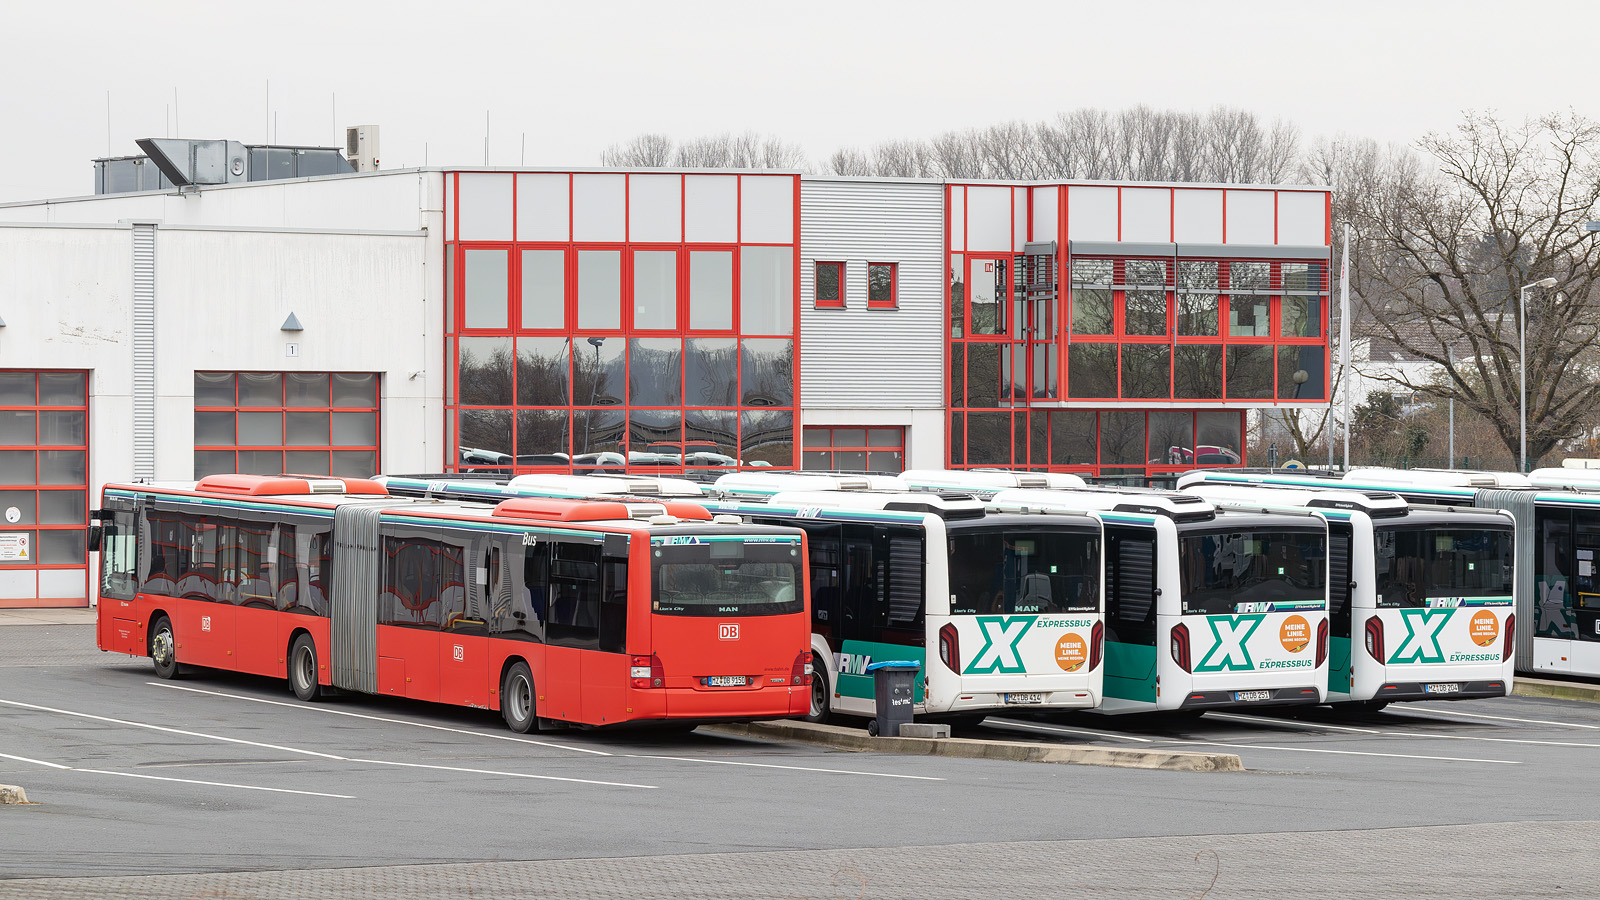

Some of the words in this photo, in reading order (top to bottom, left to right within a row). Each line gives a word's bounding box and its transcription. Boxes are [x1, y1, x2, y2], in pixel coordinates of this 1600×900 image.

[522, 532, 537, 546] Bus
[671, 536, 693, 545] RMV
[1244, 601, 1272, 613] RMV
[1436, 597, 1464, 608] RMV
[1036, 619, 1092, 628] EXPRESSBUS
[1284, 623, 1305, 631] MEINE
[720, 625, 739, 639] DB
[1386, 608, 1458, 665] X
[962, 615, 1040, 675] X
[1192, 614, 1268, 673] X
[454, 646, 463, 660] DB
[1449, 653, 1500, 662] EXPRESSBUS
[838, 653, 871, 674] RMV
[1259, 659, 1312, 669] EXPRESSBUS
